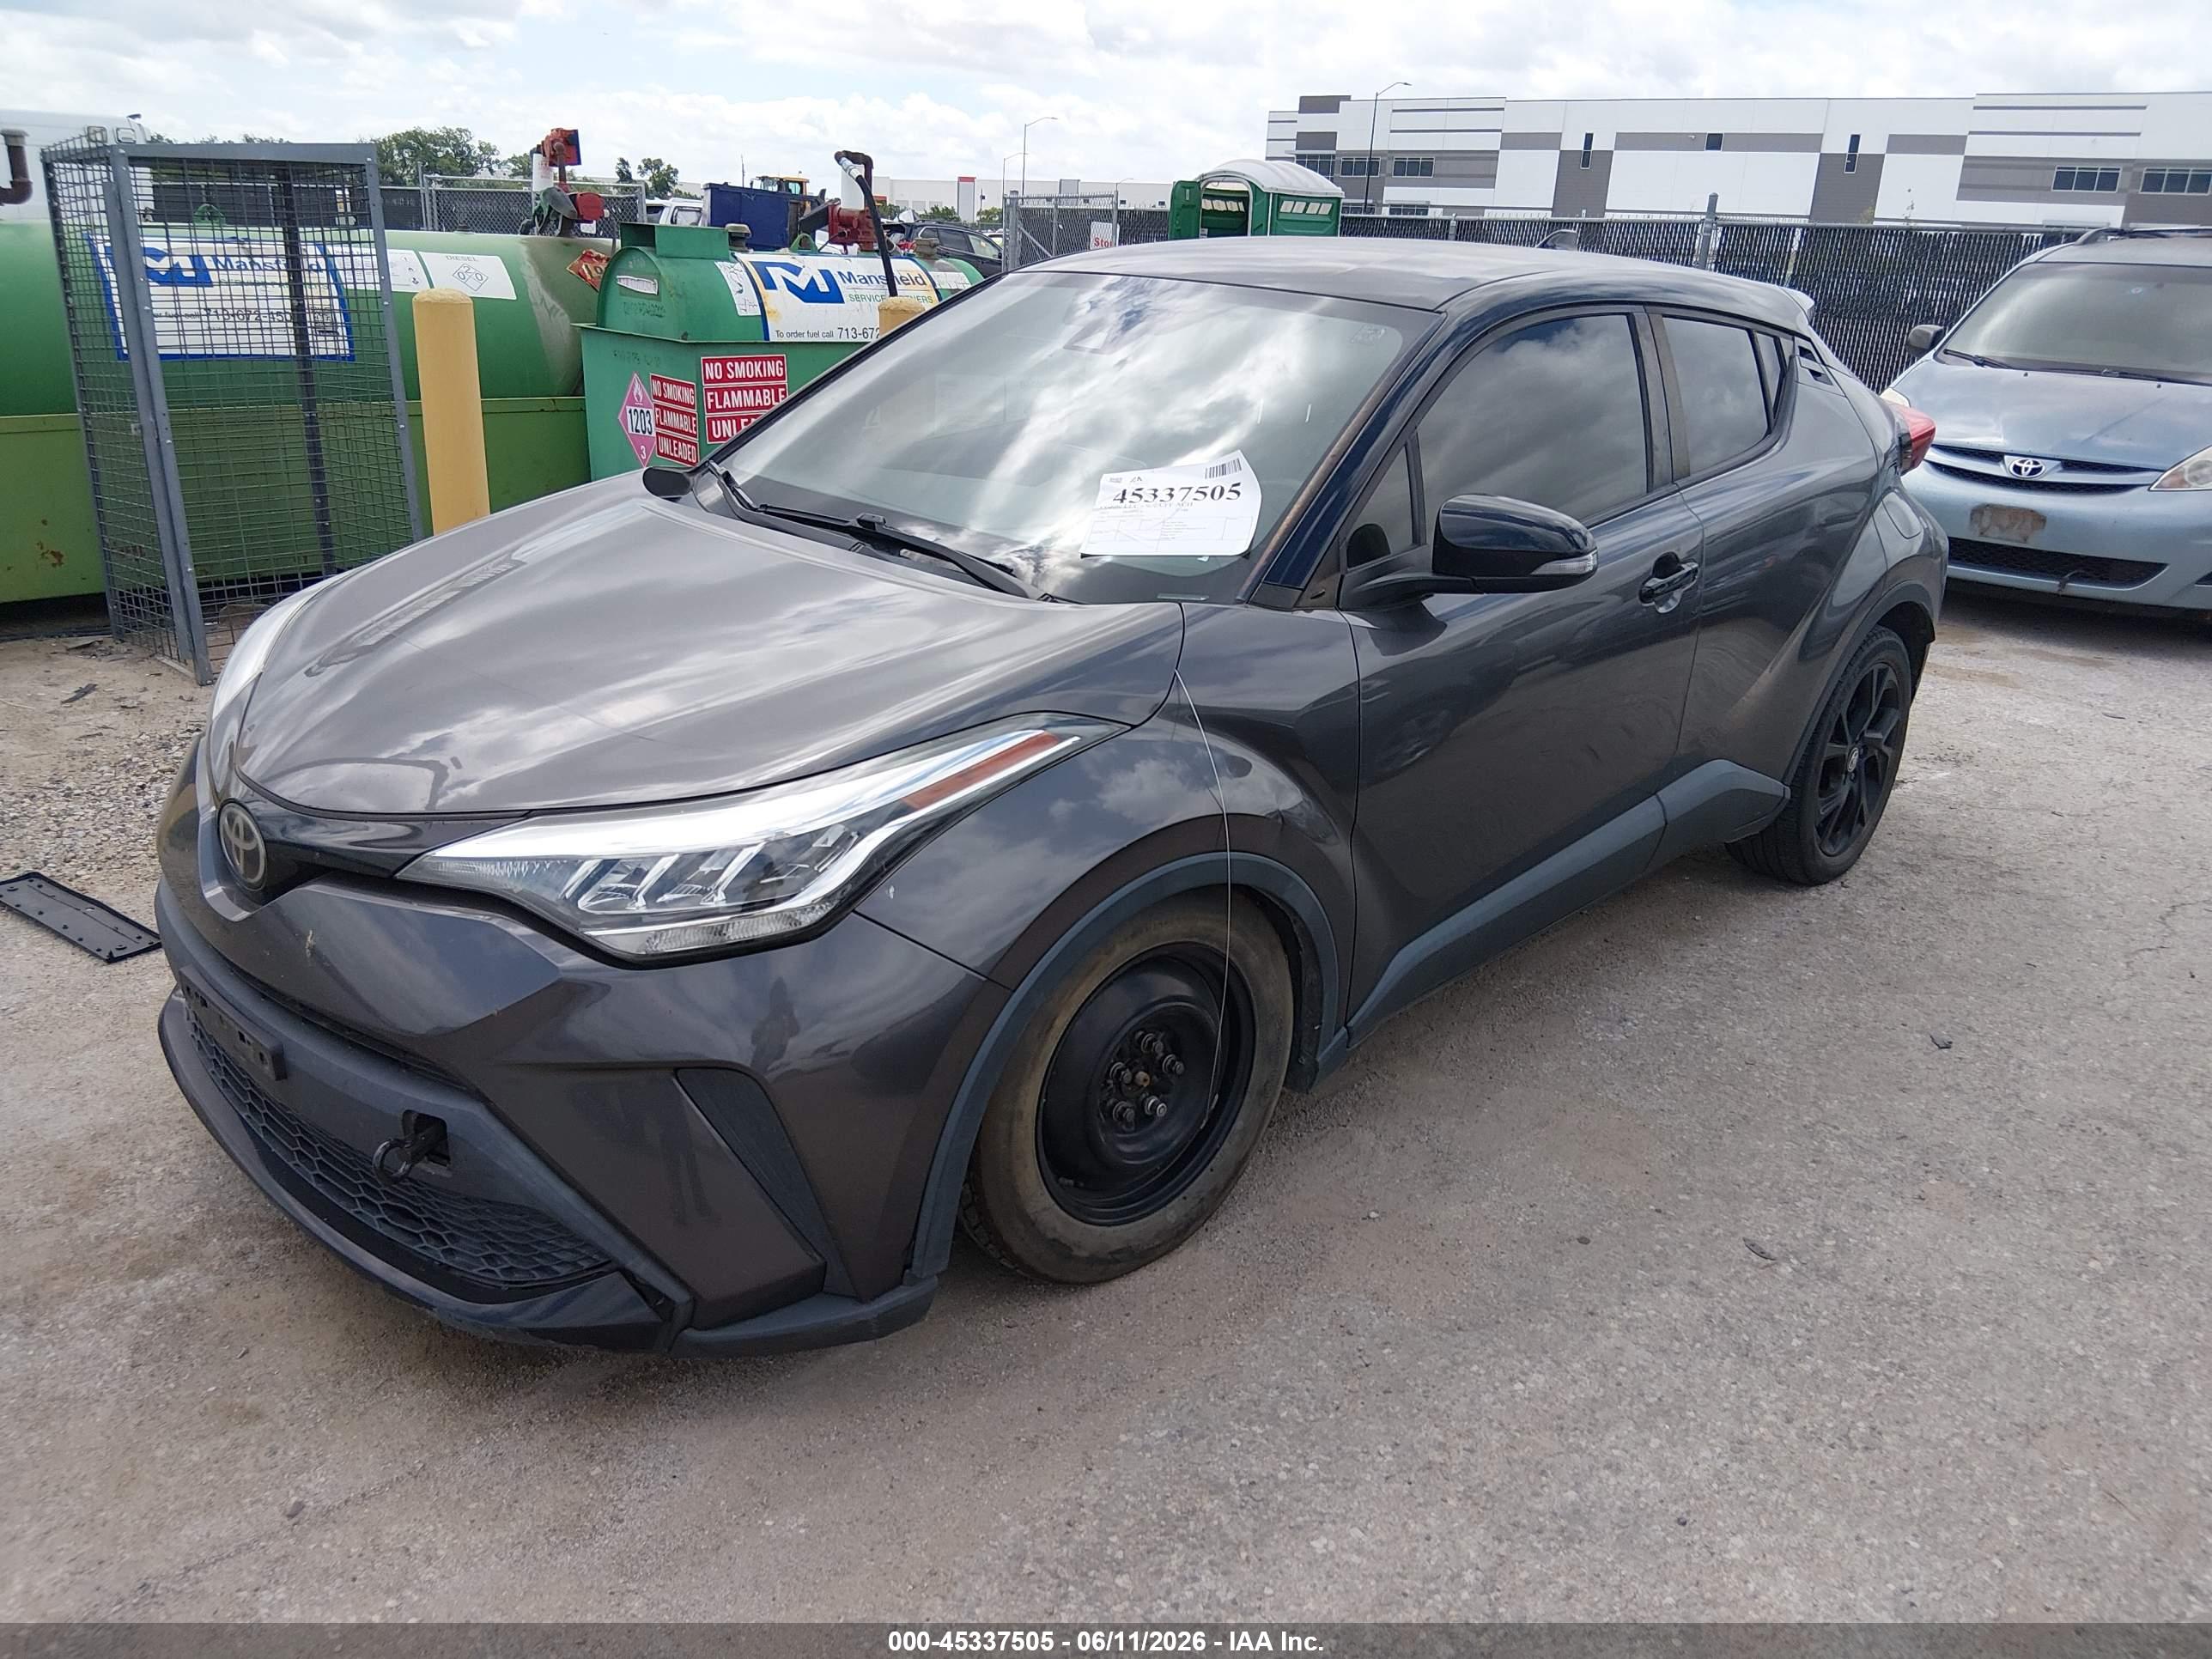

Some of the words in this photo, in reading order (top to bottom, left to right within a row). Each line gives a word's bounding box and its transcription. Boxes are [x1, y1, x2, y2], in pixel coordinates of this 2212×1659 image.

[848, 294, 886, 303] SERVICE
[775, 330, 784, 338] To
[786, 330, 805, 338] order
[807, 330, 820, 338] fuel
[822, 330, 834, 338] call
[705, 362, 723, 380] NO
[726, 360, 784, 380] SMOKING
[652, 380, 661, 398] NO
[663, 383, 696, 406] SMOKING
[707, 388, 786, 410] FLAMMABLE
[628, 408, 653, 435] 1203
[655, 410, 697, 434] FLAMMABLE
[712, 417, 755, 439] UNLE
[641, 445, 647, 459] 3
[658, 441, 696, 464] UNLEADED
[1113, 482, 1242, 504] 45337505
